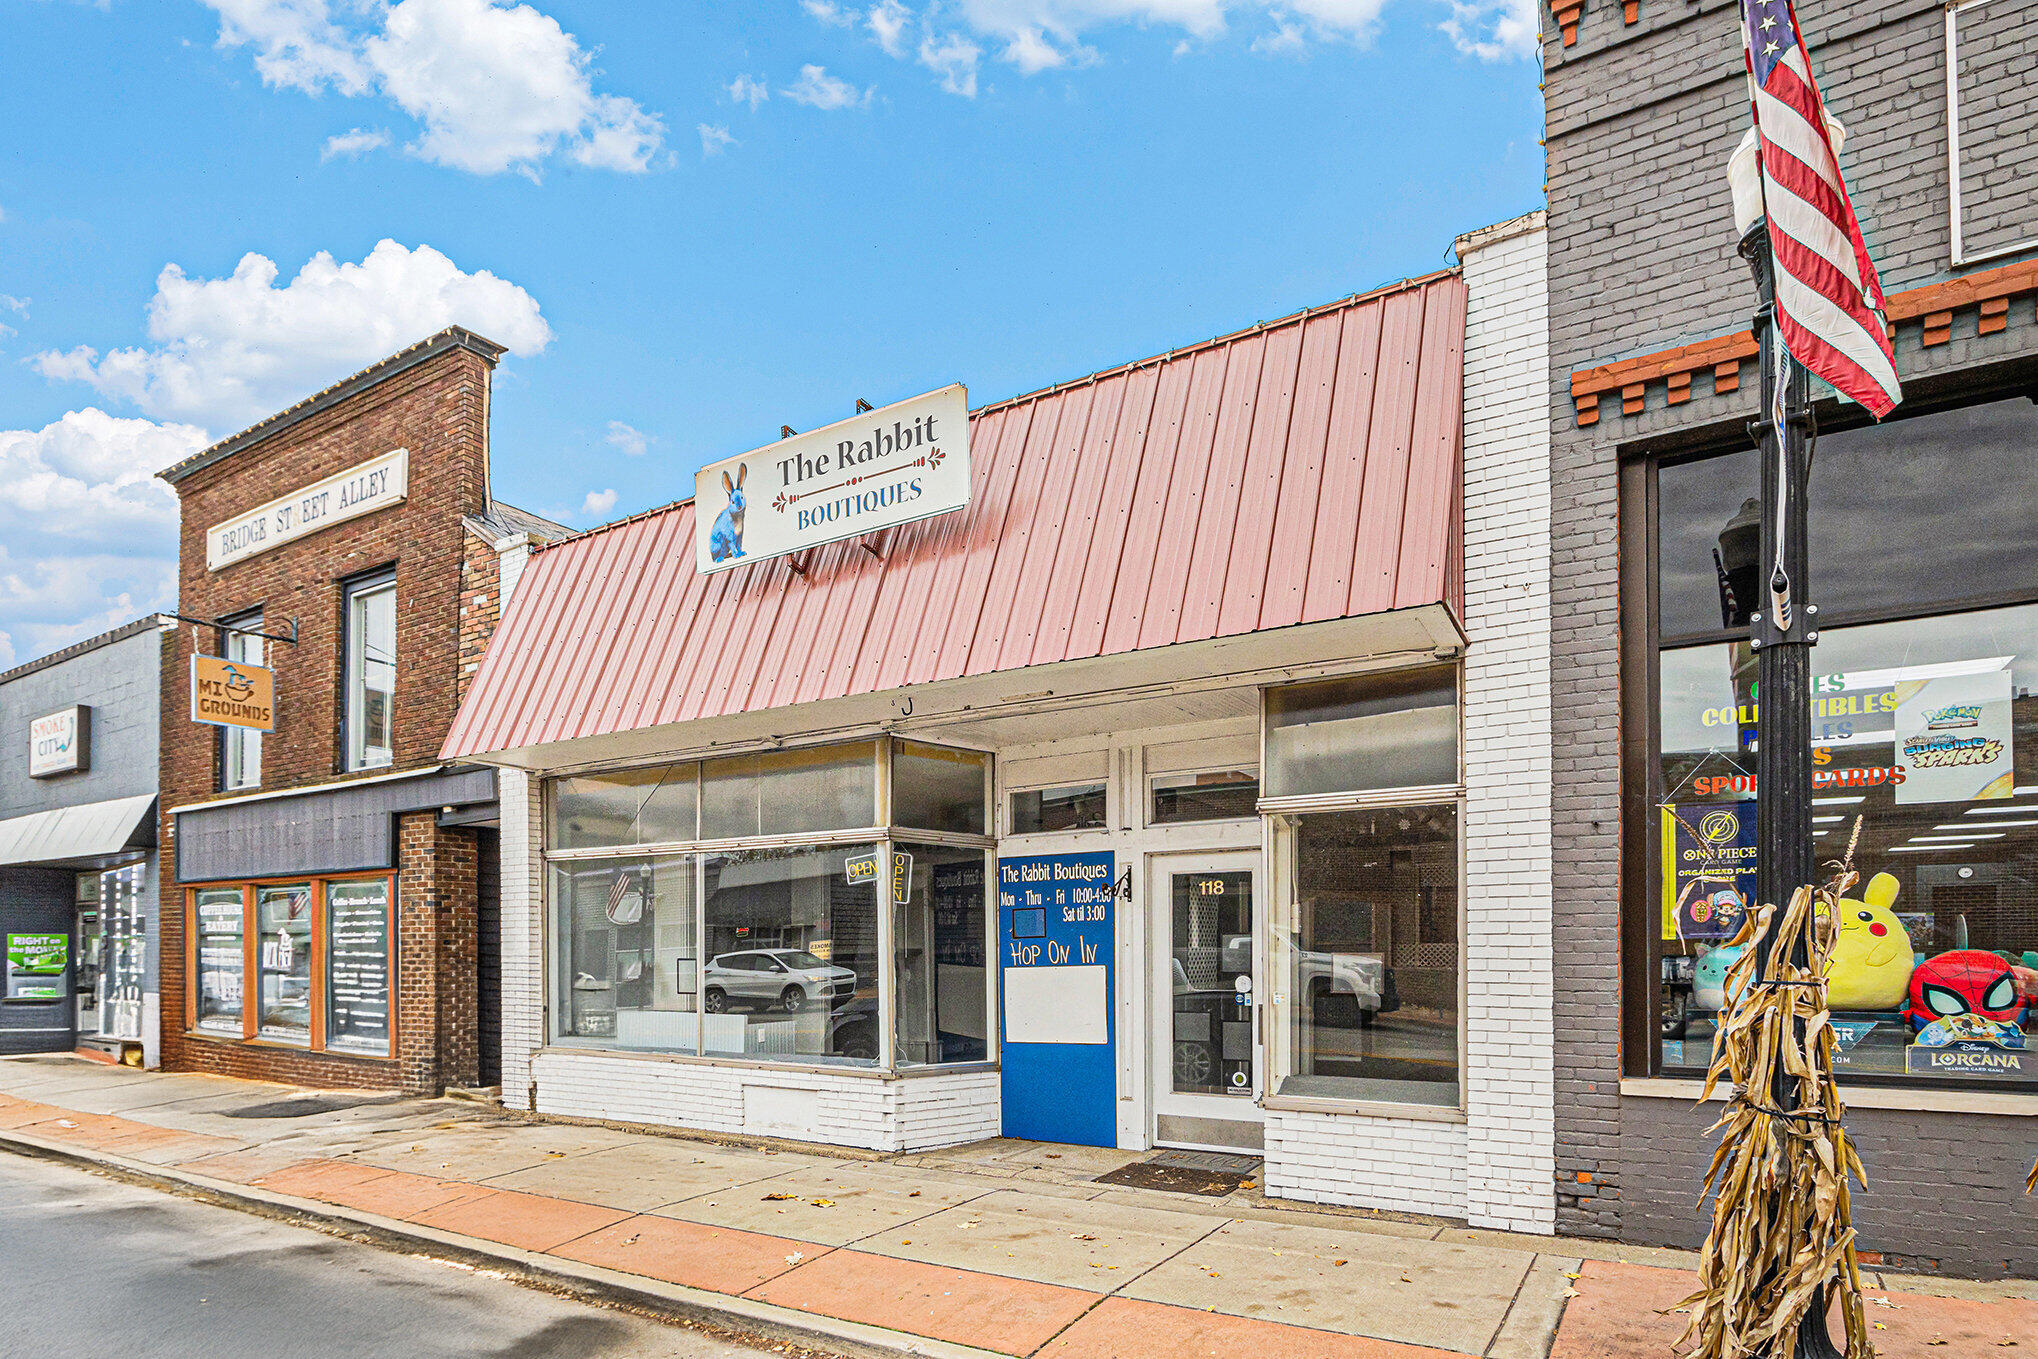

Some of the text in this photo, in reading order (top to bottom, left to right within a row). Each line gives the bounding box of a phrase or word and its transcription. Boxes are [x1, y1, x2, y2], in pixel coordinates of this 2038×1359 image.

[777, 415, 939, 487] The Rabbit
[222, 517, 266, 556] BRIDGE
[339, 468, 389, 509] ALLEY
[797, 477, 923, 531] BOUTIQUES
[199, 679, 222, 697] MI
[200, 698, 270, 721] GROUNDS
[1914, 739, 2005, 769] SPARKS
[1812, 764, 1907, 791] CARDS
[1717, 846, 1758, 860] PIECE
[848, 860, 878, 878] OPEN
[894, 854, 905, 902] OPEN
[1001, 862, 1107, 883] The Rabbit Boutiques
[1678, 867, 1734, 877] ORGANIZED
[1199, 880, 1224, 895] 118
[1000, 892, 1015, 907] Mon
[1025, 889, 1042, 906] Thru
[1056, 889, 1065, 904] Fri
[1062, 904, 1105, 922] Sat til 3:00
[13, 936, 49, 946] RIGHT
[1010, 941, 1041, 966] HOP
[1958, 1042, 1990, 1054] Disney
[1931, 1053, 2021, 1069] LORCANA
